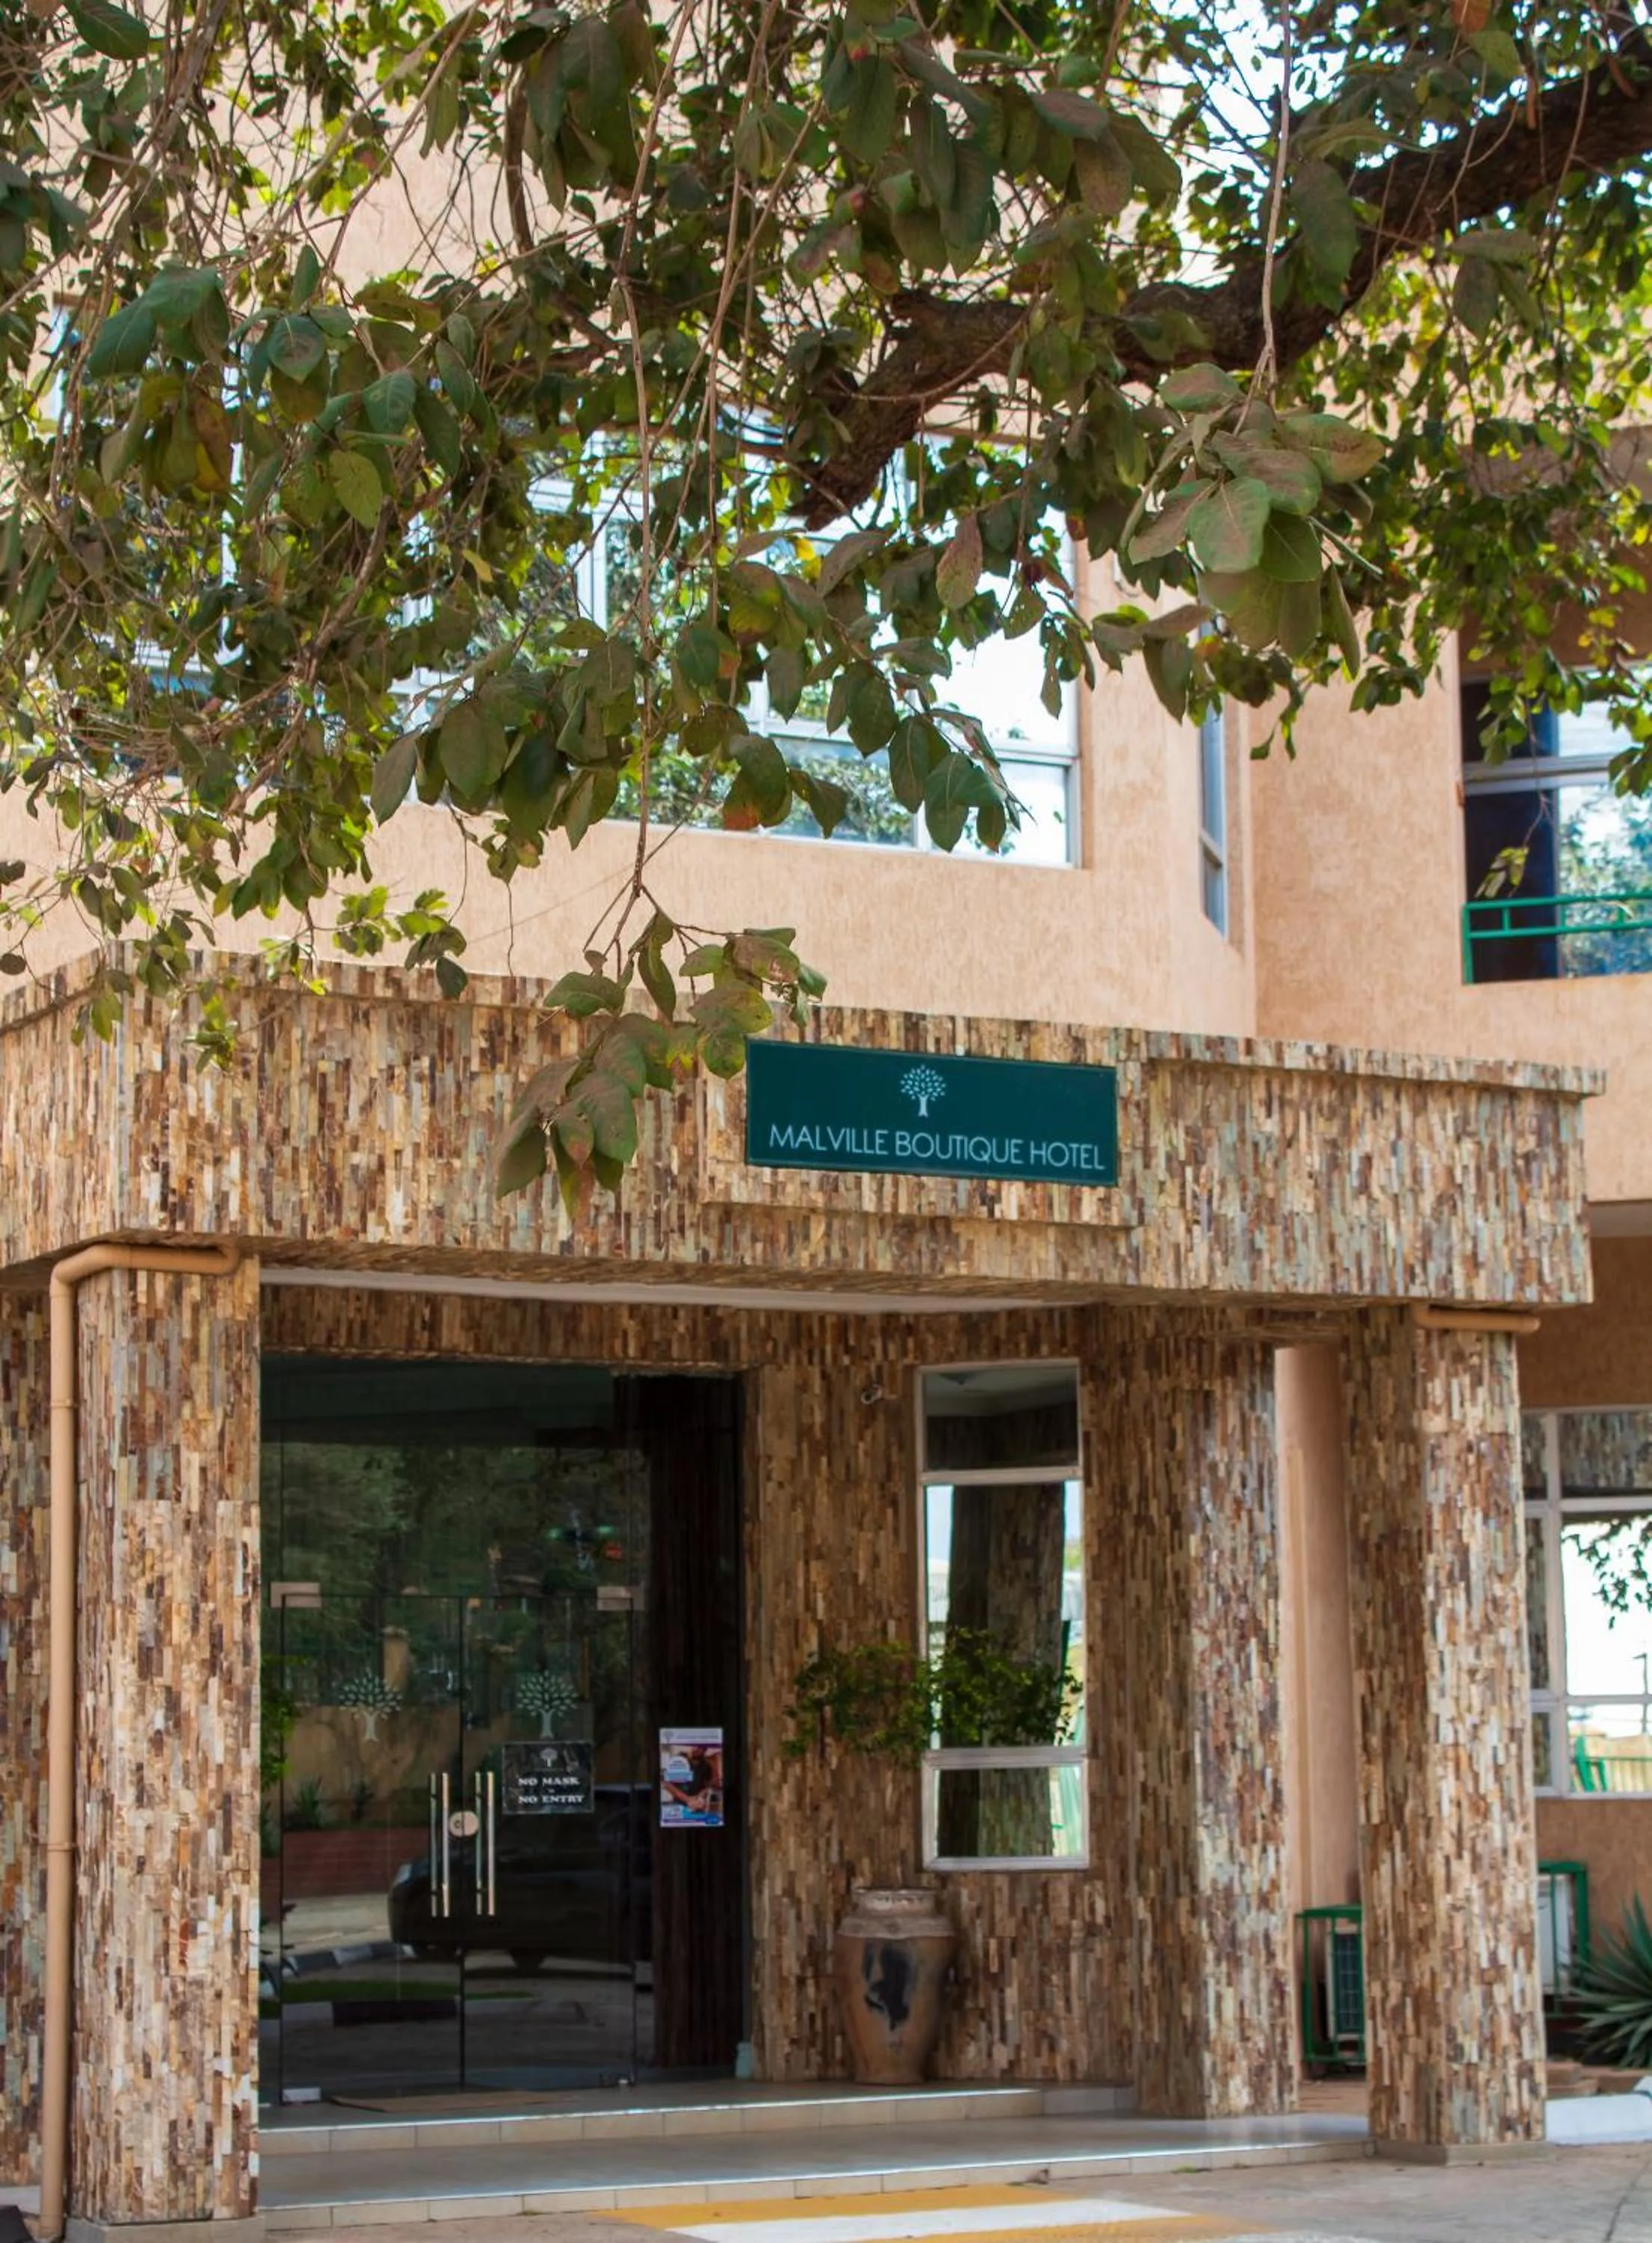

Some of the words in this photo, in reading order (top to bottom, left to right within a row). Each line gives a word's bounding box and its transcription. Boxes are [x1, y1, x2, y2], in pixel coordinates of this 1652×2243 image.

[769, 1124, 888, 1155] MALVILLE
[896, 1131, 1024, 1163] BOUTIQUE
[1030, 1141, 1106, 1169] HOTEL
[517, 1777, 538, 1786] NO
[542, 1777, 580, 1787] MASK
[517, 1795, 538, 1804] NO
[542, 1795, 585, 1803] ENTRY
